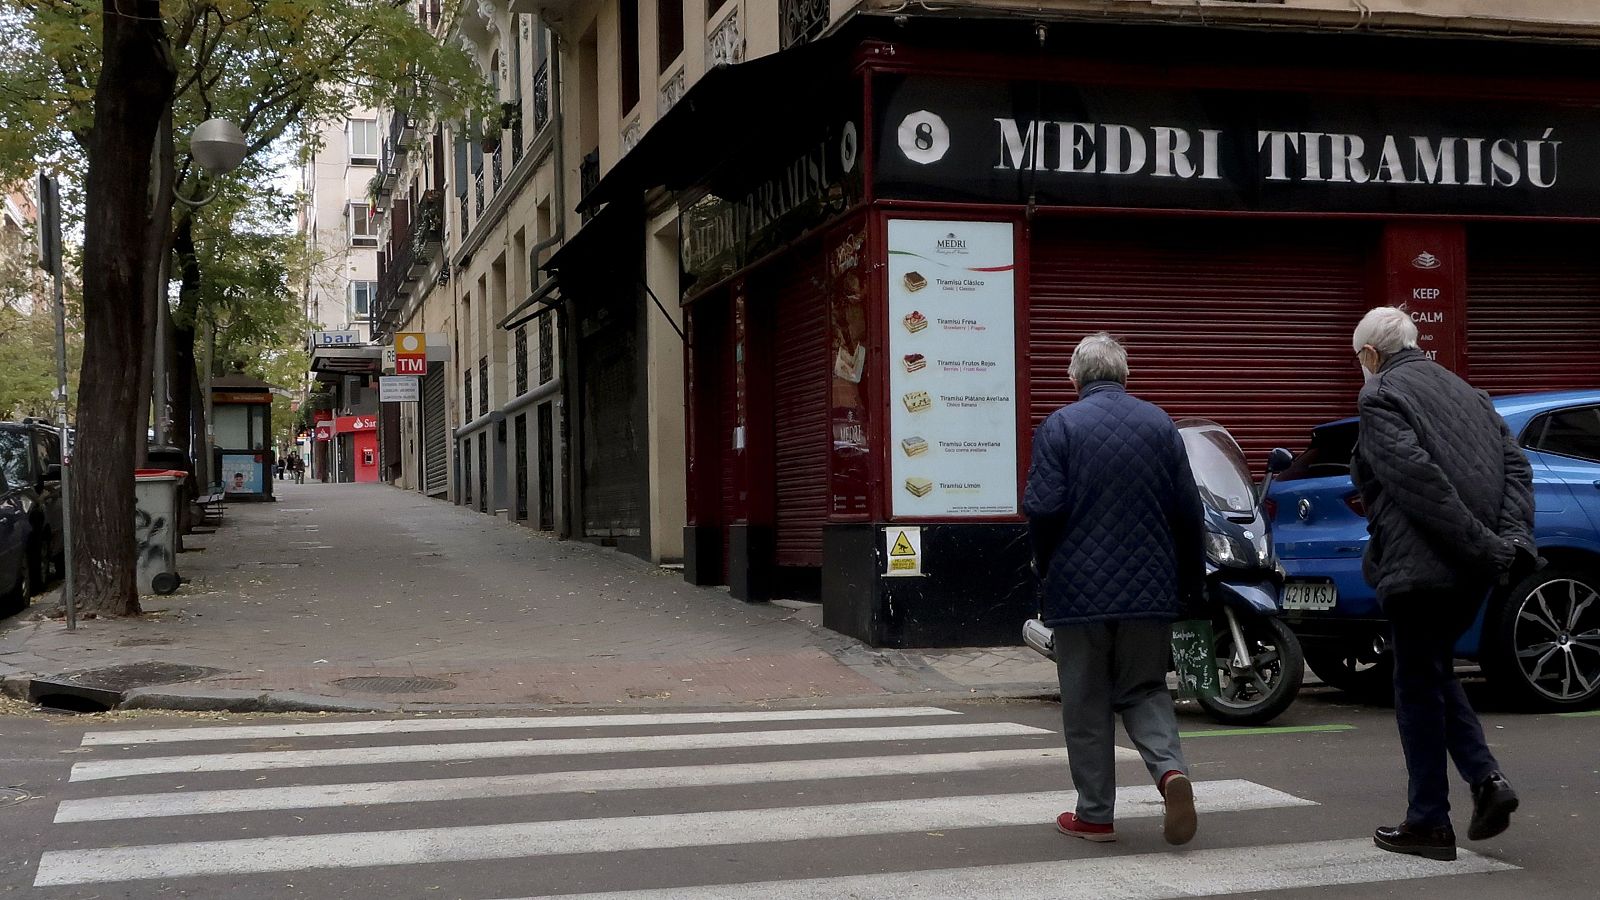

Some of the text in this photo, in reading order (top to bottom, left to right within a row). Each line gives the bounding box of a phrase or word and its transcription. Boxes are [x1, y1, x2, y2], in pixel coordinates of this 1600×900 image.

[914, 122, 934, 151] 8
[994, 117, 1563, 189] MEDRI TIRAMISÚ
[937, 239, 966, 248] MEDRI
[1412, 288, 1440, 300] KEEP
[1410, 311, 1443, 323] CALM
[323, 333, 353, 344] bar
[1420, 350, 1438, 361] AT
[397, 358, 423, 371] TM
[1285, 586, 1335, 604] 4218 KSJ
